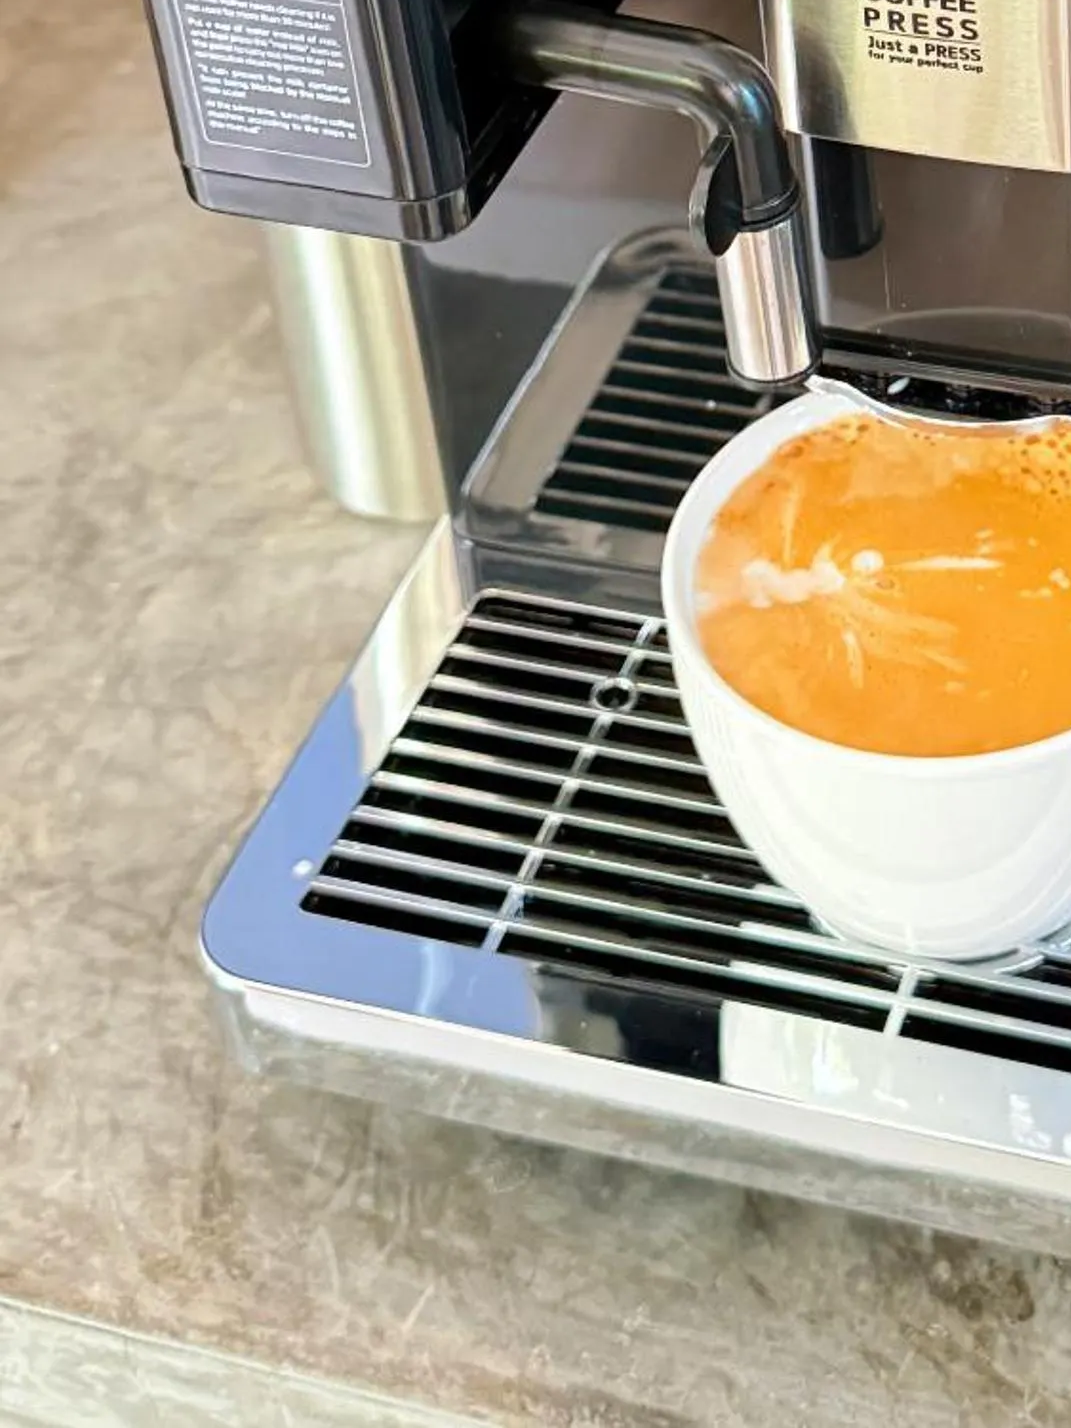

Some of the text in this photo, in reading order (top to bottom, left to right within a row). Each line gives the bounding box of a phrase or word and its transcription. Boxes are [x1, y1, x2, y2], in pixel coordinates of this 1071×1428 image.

[863, 7, 979, 40] PRESS
[868, 35, 981, 62] Just a PRESS
[868, 49, 984, 74] for your perfect cup
